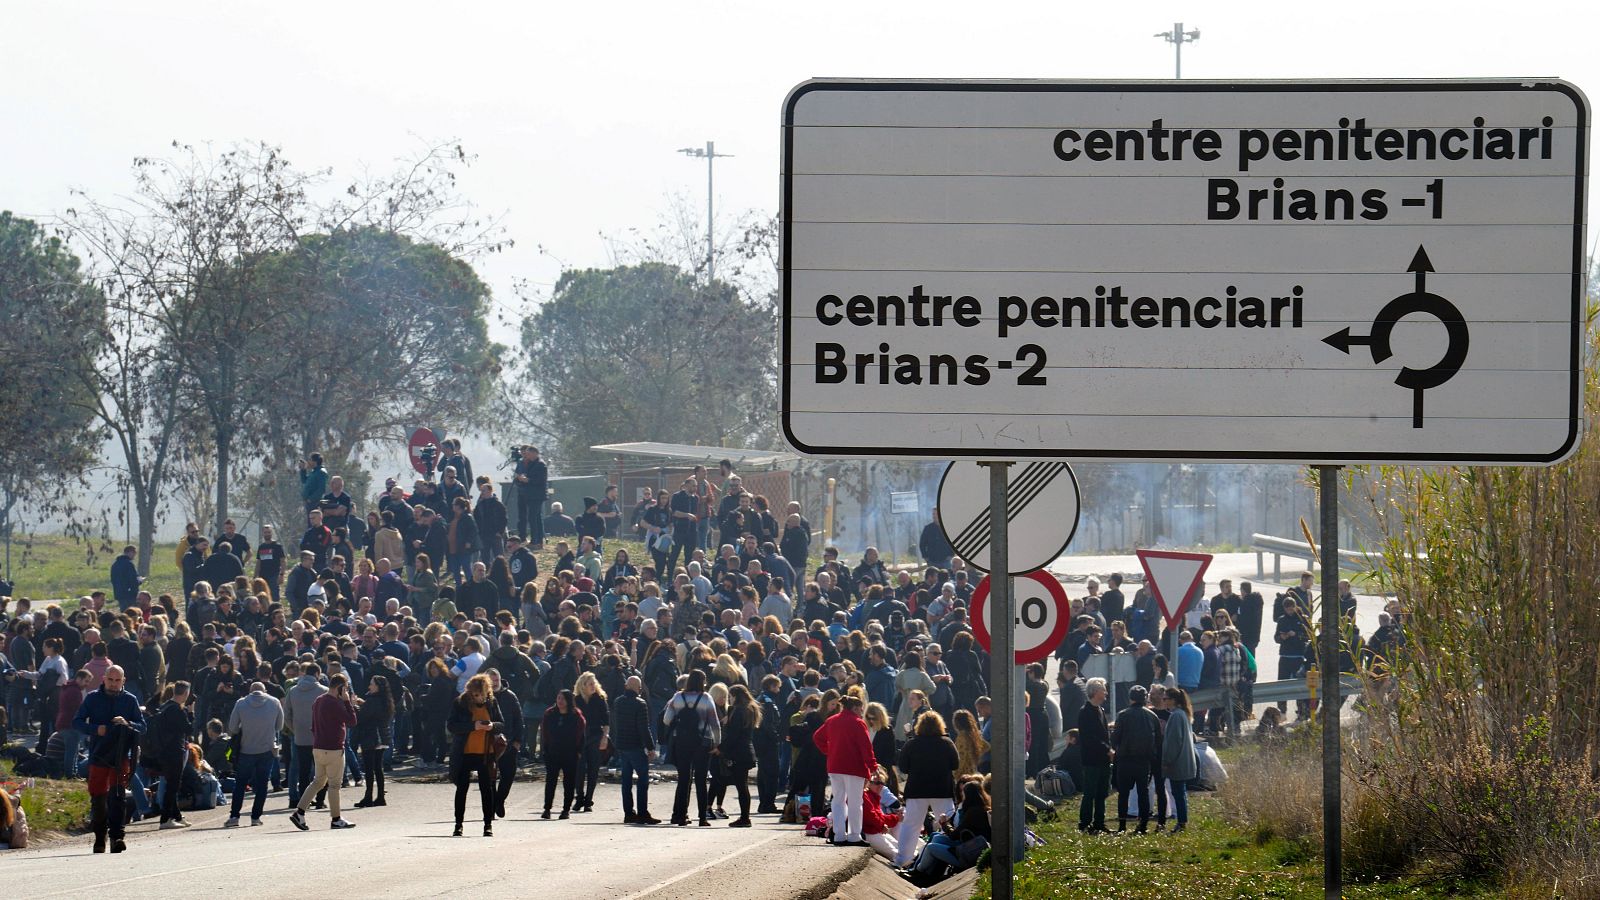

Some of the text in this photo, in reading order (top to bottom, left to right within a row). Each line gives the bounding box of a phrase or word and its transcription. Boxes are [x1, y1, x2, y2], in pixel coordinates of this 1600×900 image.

[1053, 115, 1554, 172] centre penitenciari
[1207, 177, 1389, 221] Brians
[815, 284, 1304, 338] centre penitenciari
[814, 342, 1047, 386] Brians-2
